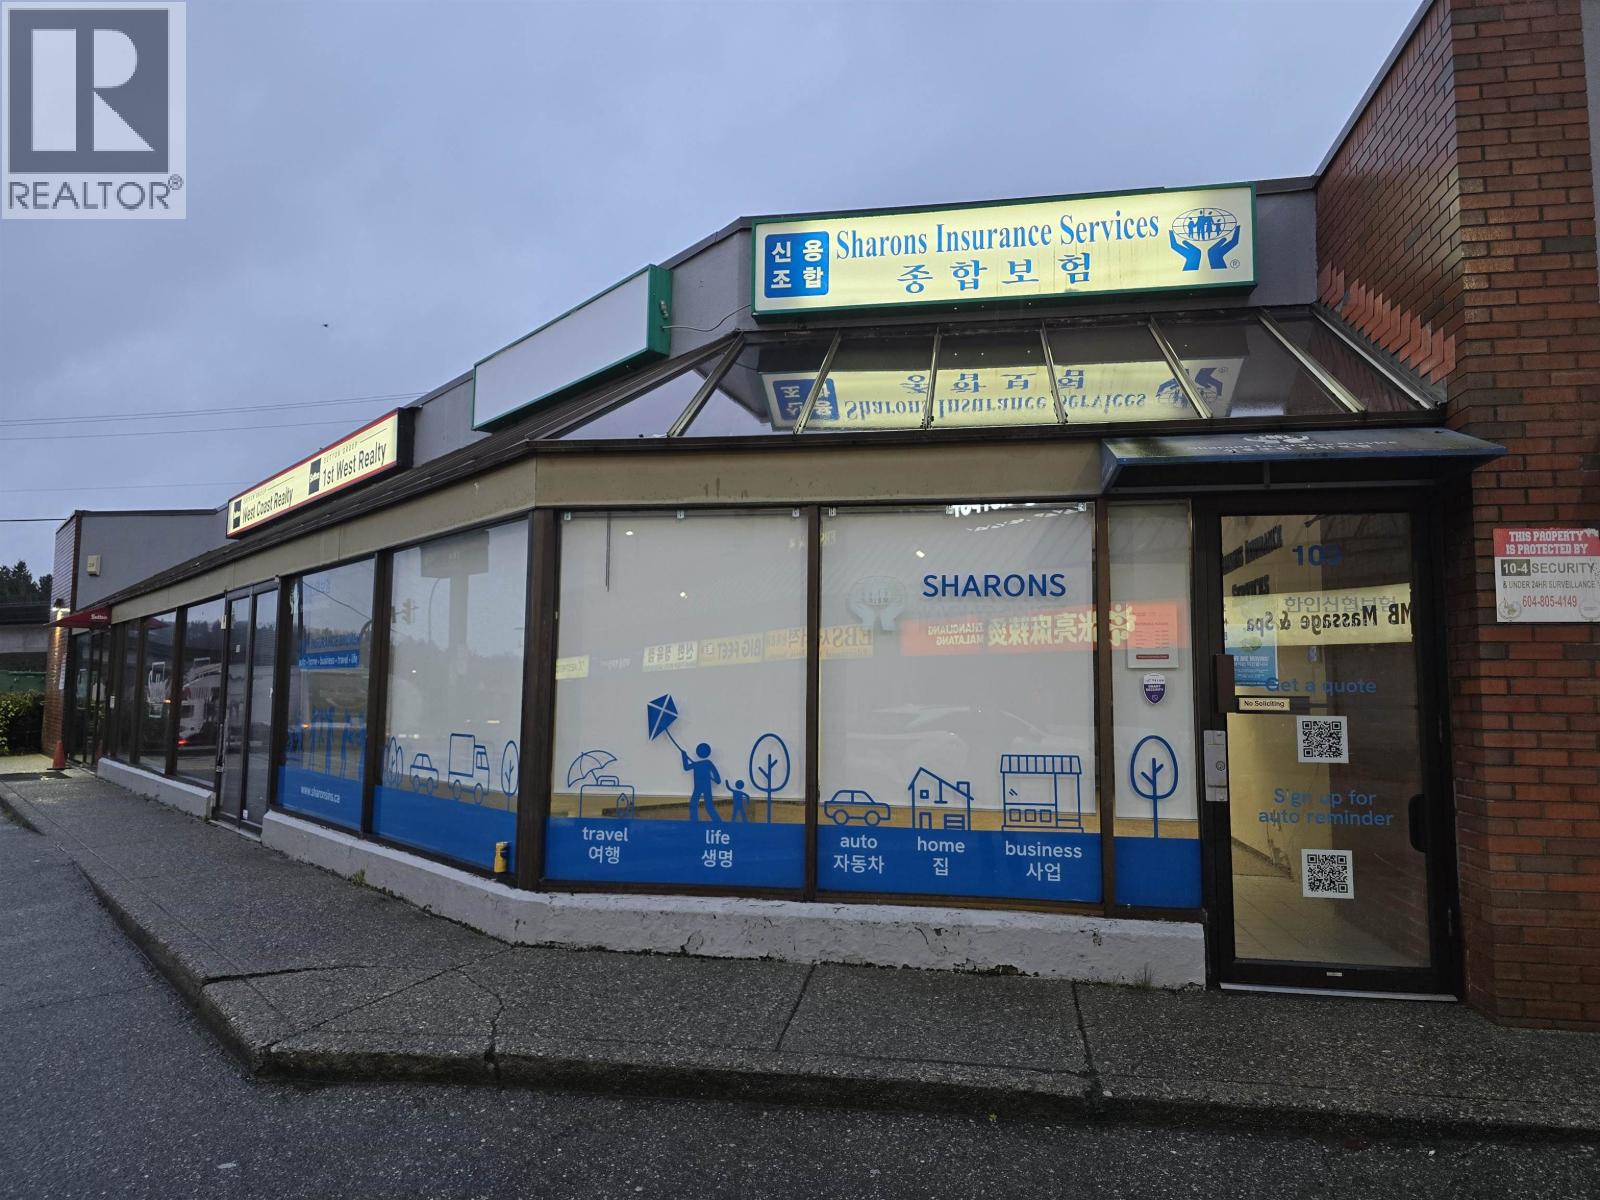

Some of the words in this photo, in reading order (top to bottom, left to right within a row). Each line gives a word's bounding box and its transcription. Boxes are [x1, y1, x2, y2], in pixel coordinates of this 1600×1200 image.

[836, 229, 927, 260] Sharons
[936, 223, 1052, 253] Insurance
[1060, 210, 1159, 246] Services
[323, 465, 335, 487] 1st
[336, 455, 357, 480] West
[358, 441, 387, 471] Realty
[242, 504, 256, 523] West
[256, 495, 273, 517] Coast
[273, 486, 294, 510] Realty
[1509, 530, 1532, 542] THIS
[1533, 530, 1585, 542] PROPERTY
[1505, 543, 1516, 555] IS
[1517, 543, 1572, 555] PROTECTED
[1574, 543, 1589, 554] BY
[1503, 563, 1528, 574] 10-4
[1531, 562, 1596, 574] SECURITY
[922, 572, 1067, 598] SHARONS
[1509, 580, 1530, 589] UNDER
[1531, 580, 1548, 589] 24HR
[1549, 580, 1595, 589] SURVEILLANCE
[1265, 677, 1298, 693] Get
[1305, 680, 1317, 692] a
[1323, 678, 1377, 696] quote
[1254, 700, 1285, 709] Soliciting
[1347, 789, 1377, 806] for
[1258, 809, 1300, 825] auto
[1306, 809, 1394, 827] reminder
[582, 826, 629, 842] travel
[705, 829, 731, 845] life
[840, 834, 878, 849] auto
[917, 836, 966, 853] home
[1005, 840, 1083, 859] business
[588, 845, 621, 864] 여행
[701, 849, 734, 868] 생명
[833, 854, 885, 874] 자동차
[932, 857, 949, 876] 집
[1026, 862, 1062, 882] 사업
